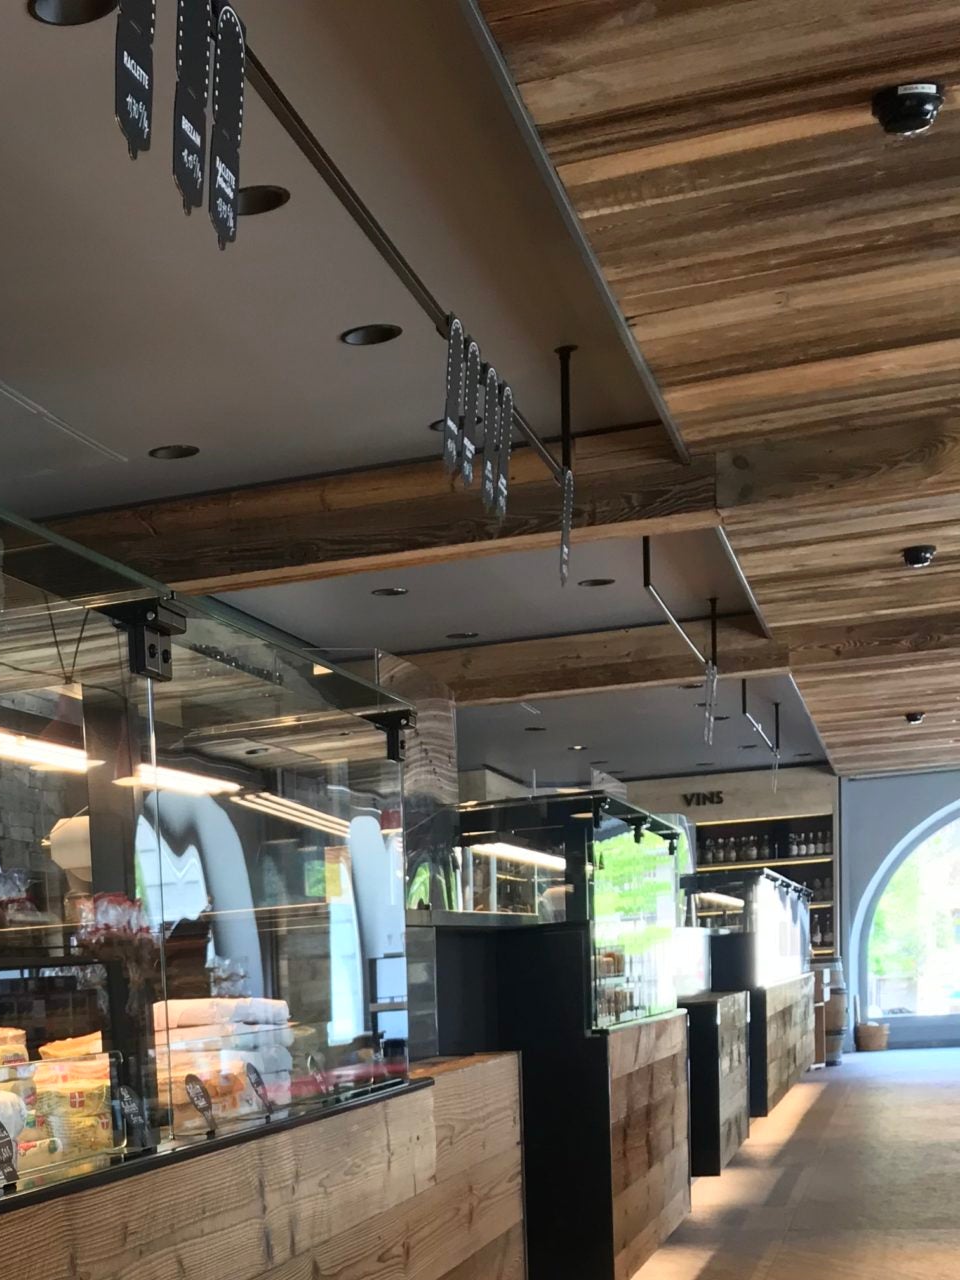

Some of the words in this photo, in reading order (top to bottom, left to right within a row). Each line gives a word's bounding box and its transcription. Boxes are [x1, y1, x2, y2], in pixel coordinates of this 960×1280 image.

[123, 50, 149, 90] RACLETTE
[216, 155, 236, 189] RACLETTE
[681, 790, 724, 807] VINS
